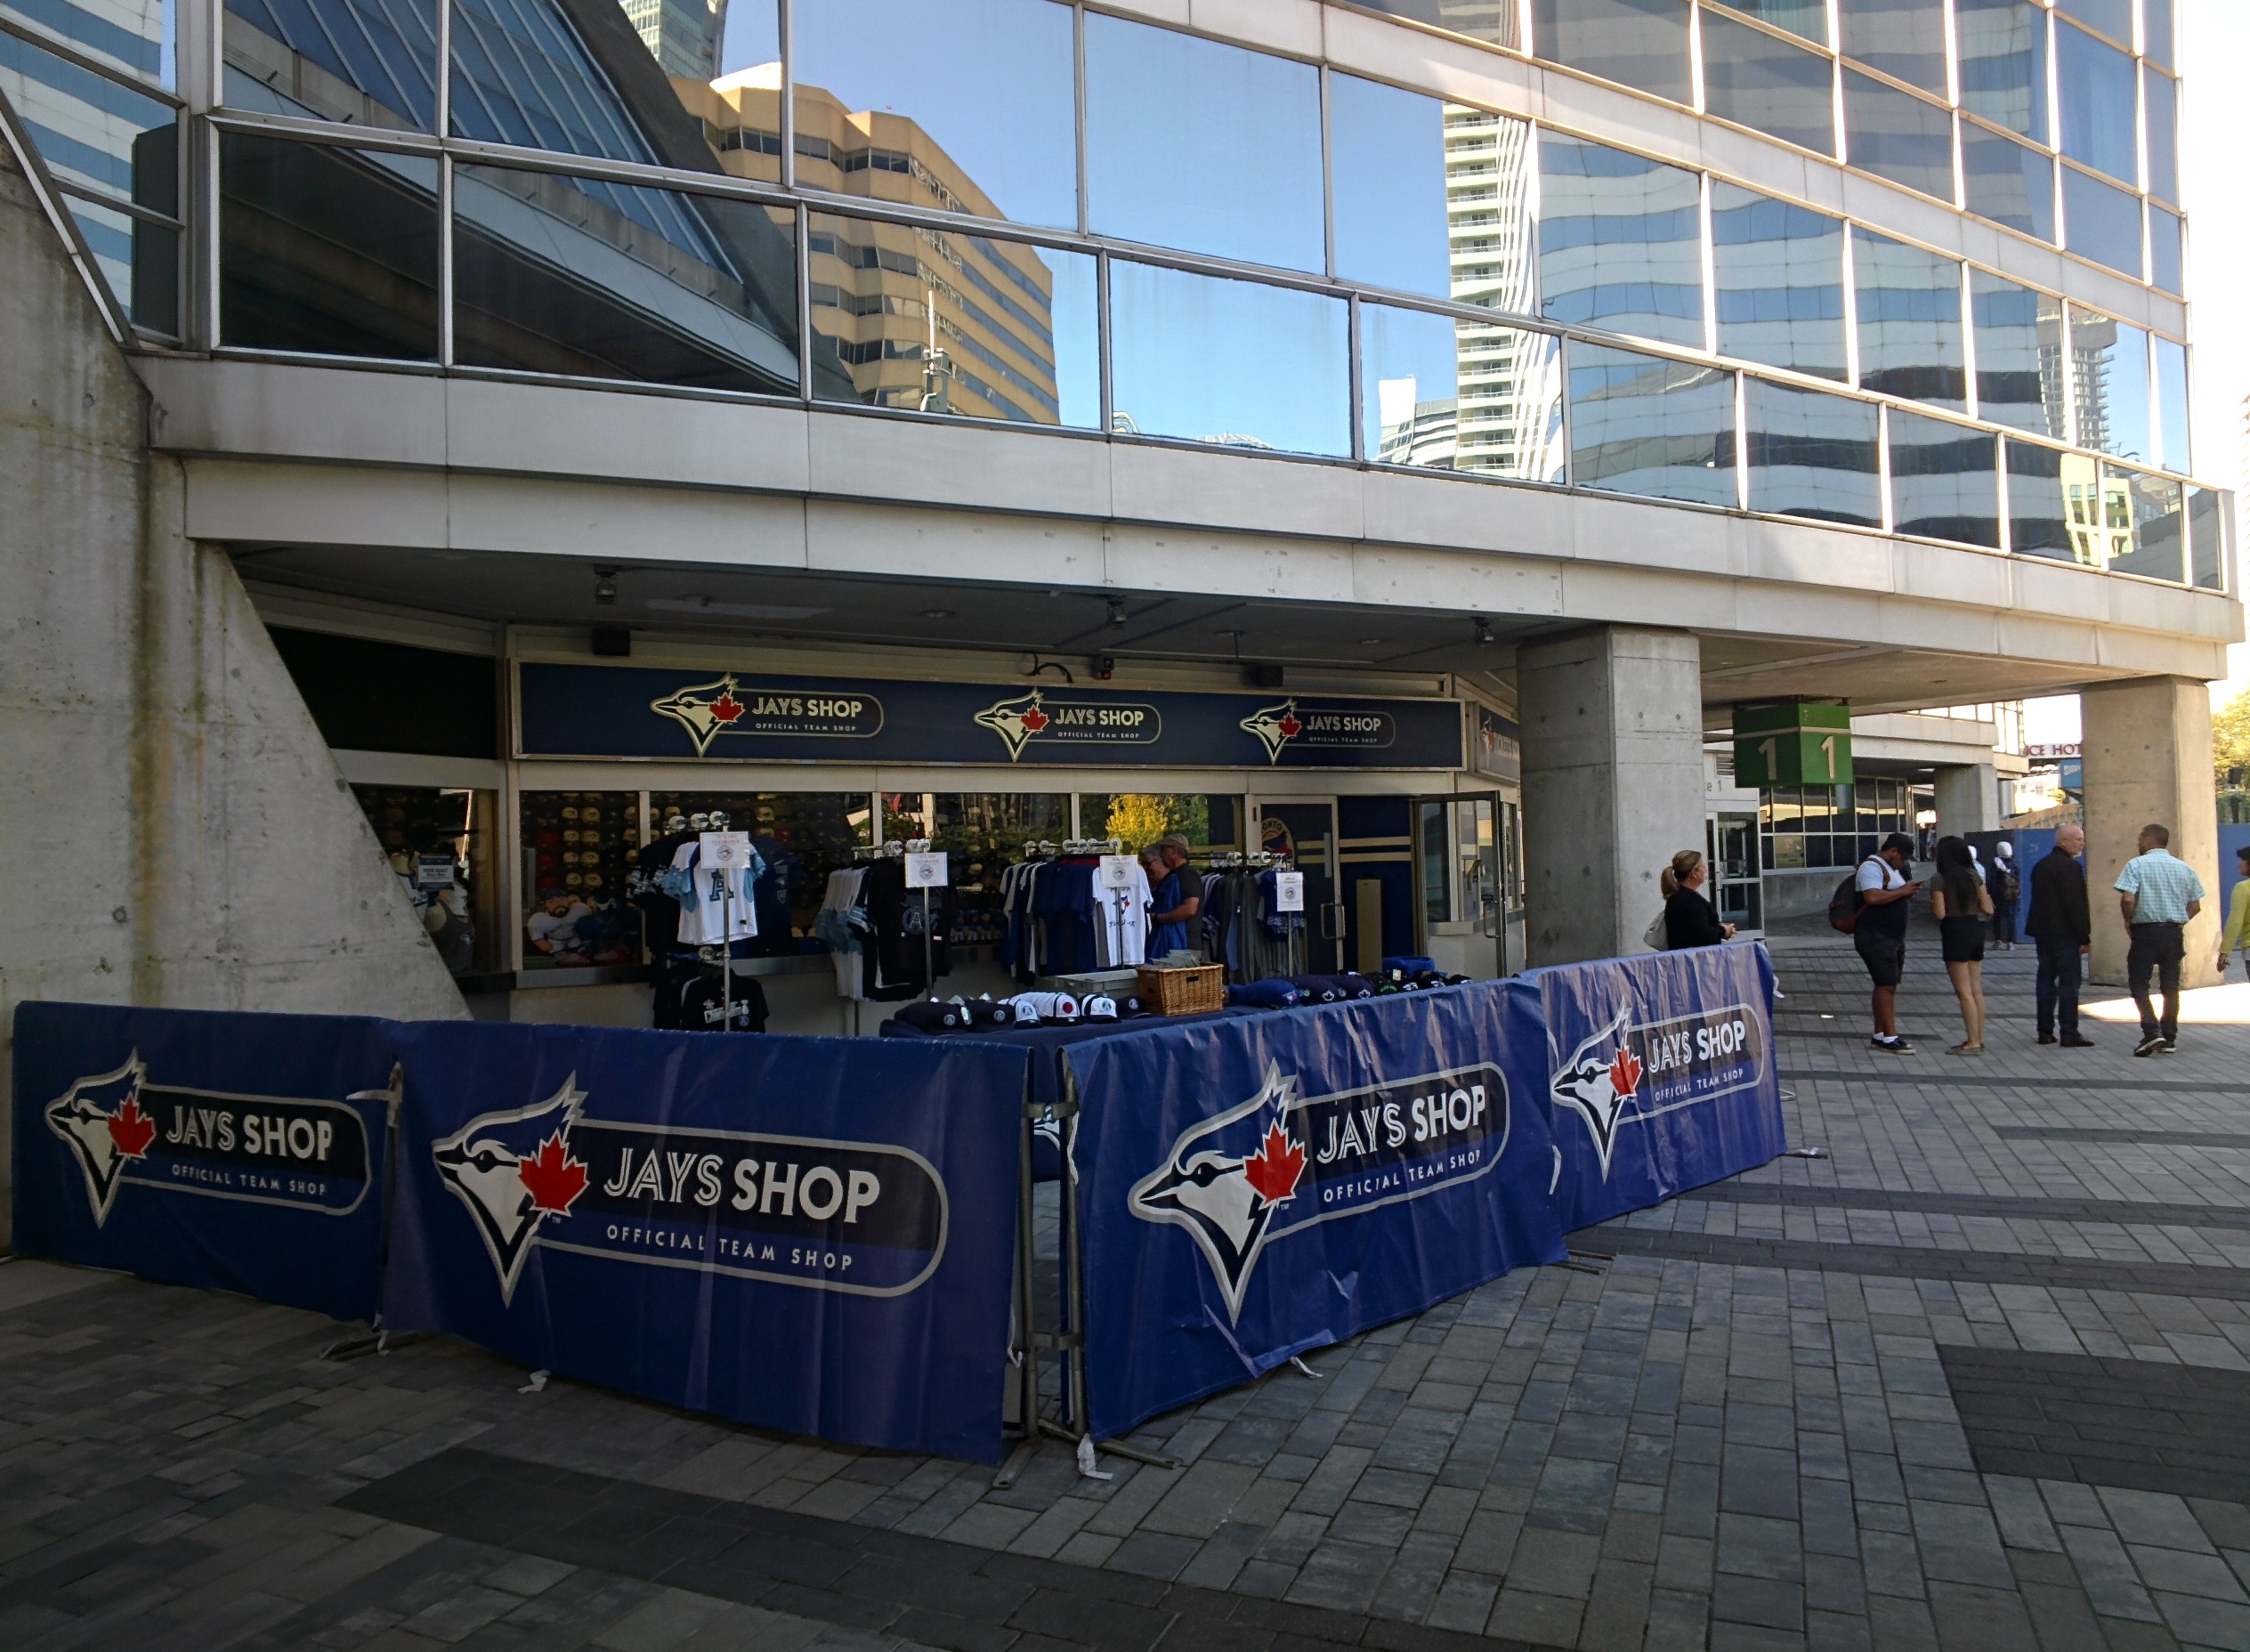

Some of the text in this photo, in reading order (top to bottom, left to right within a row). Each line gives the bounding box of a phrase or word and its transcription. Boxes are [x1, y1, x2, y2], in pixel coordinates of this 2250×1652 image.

[752, 697, 862, 718] JAYS SHOP
[1055, 709, 1144, 726] JAYS SHOP
[1307, 716, 1381, 732] JAYS SHOP
[1758, 736, 1777, 781] 1
[1822, 735, 1835, 780] 1
[1717, 780, 1722, 792] 1
[1648, 1020, 1745, 1073] JAYS SHOP
[1655, 1067, 1744, 1102] OFFICIAL TEAM SHOP
[166, 1105, 332, 1161] JAYS SHOP
[1316, 1084, 1485, 1164] JAYS SHOP
[172, 1163, 328, 1196] OFFICIAL TEAM SHOP
[603, 1147, 880, 1224] JAYS SHOP
[1323, 1149, 1481, 1203] OFFICIAL TEAM SHOP
[607, 1225, 853, 1271] OFFICIAL TEAM SHOP
